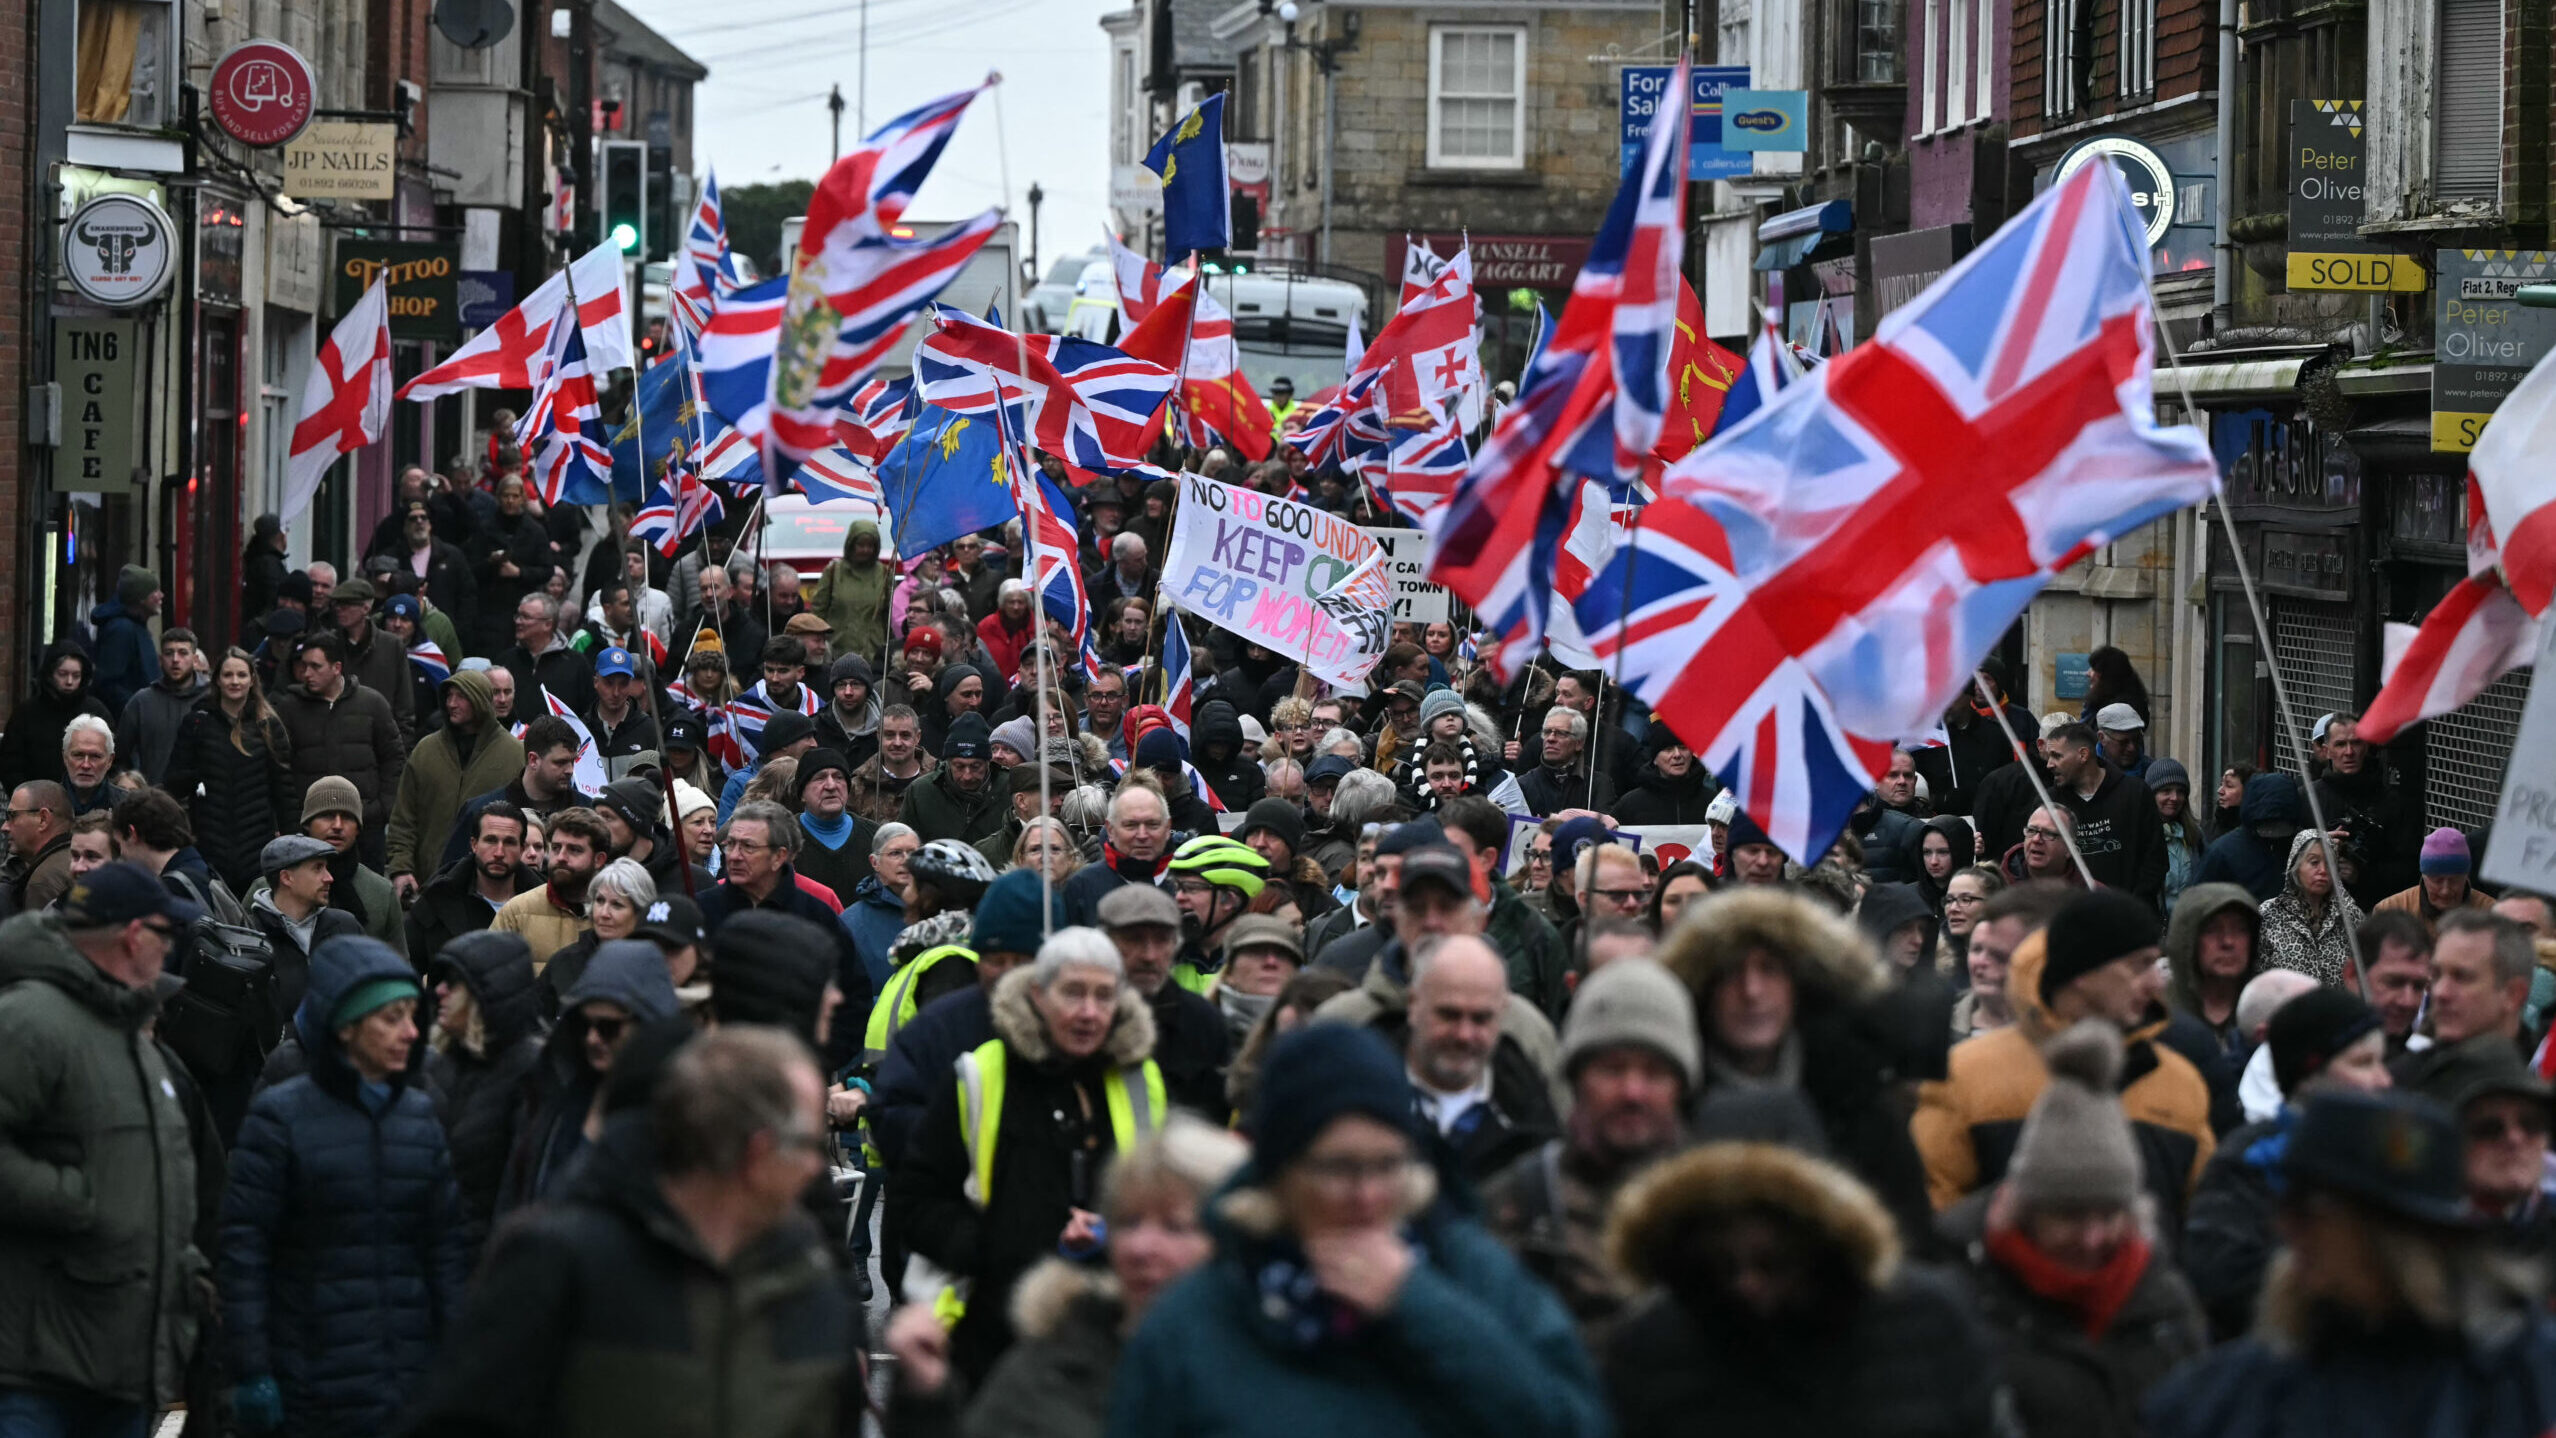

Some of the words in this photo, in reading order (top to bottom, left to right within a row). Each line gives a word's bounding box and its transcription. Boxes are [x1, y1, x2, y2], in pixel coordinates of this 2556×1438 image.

[1628, 73, 1664, 92] For
[215, 89, 226, 111] BUY
[223, 113, 242, 133] AND
[243, 128, 270, 141] SELL
[272, 122, 294, 138] FOR
[291, 92, 307, 122] CASH
[1627, 96, 1661, 116] Sal
[1627, 123, 1651, 137] Fre
[288, 150, 315, 170] JP
[321, 151, 389, 172] NAILS
[2301, 147, 2357, 170] Peter
[2322, 214, 2354, 225] 01892
[112, 234, 120, 274] TORO
[344, 256, 450, 293] TTTOO
[1471, 261, 1566, 281] TAGGART
[2311, 258, 2392, 287] SOLD
[2462, 280, 2482, 294] Flat
[2485, 280, 2494, 297] 2,
[388, 295, 439, 317] HOP
[2446, 300, 2510, 325] Peter
[67, 331, 118, 361] TN6
[2445, 331, 2525, 358] Oliver
[2475, 370, 2508, 382] 01892
[81, 372, 103, 479] CAFE
[1189, 477, 1226, 511] NO
[1226, 487, 1262, 521] TO
[1265, 499, 1312, 540] 600
[1211, 517, 1305, 586] KEEP
[1182, 565, 1258, 621] FOR
[1397, 580, 1444, 594] TOWN
[1393, 598, 1413, 617] Y!
[1246, 587, 1352, 665] WOMEN
